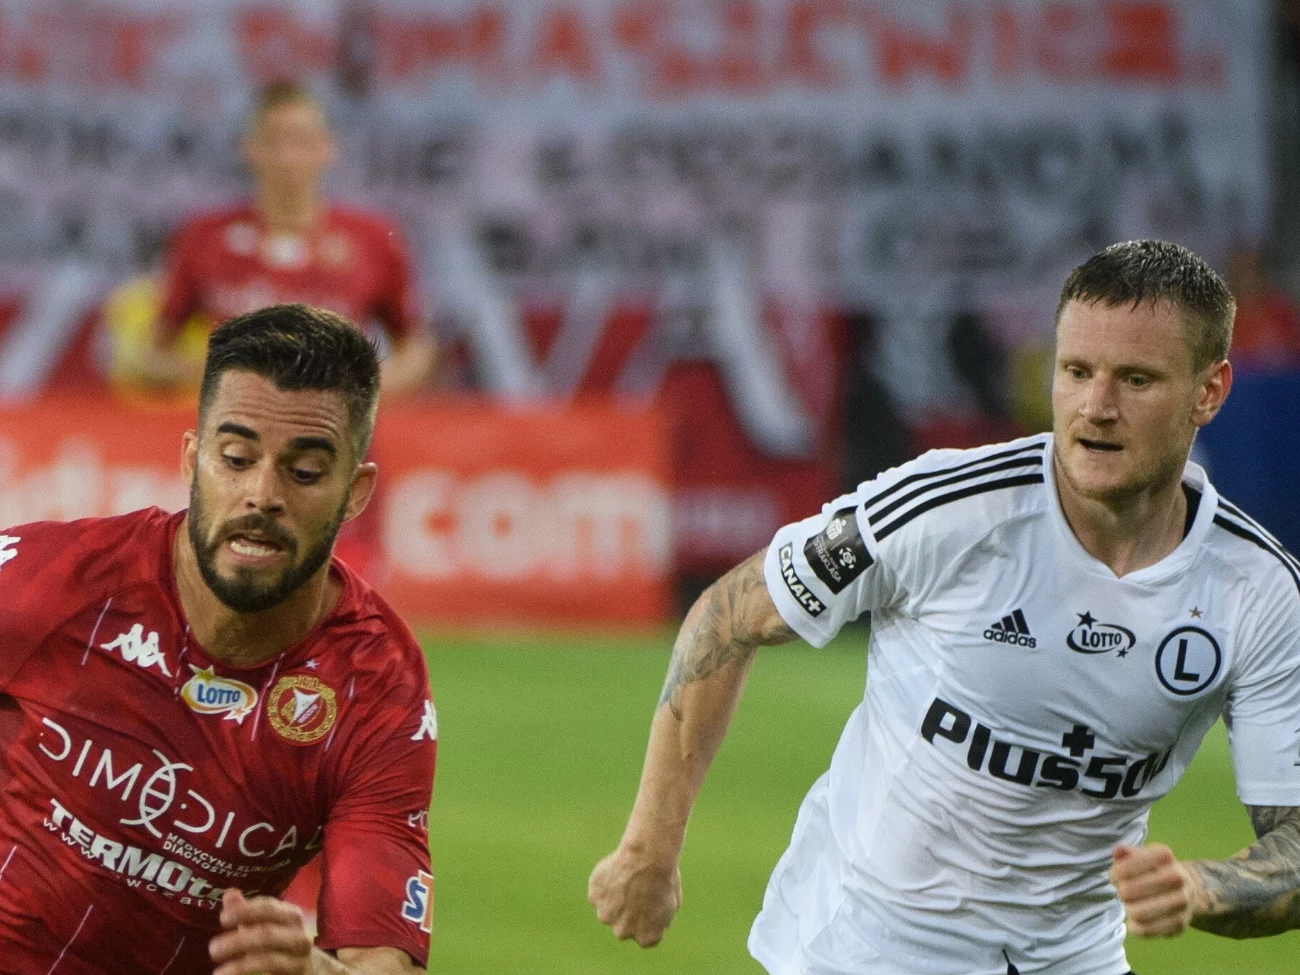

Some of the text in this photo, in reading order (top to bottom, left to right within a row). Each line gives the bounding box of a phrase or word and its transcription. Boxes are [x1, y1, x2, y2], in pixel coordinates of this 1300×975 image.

[780, 545, 821, 613] CANAL+
[983, 627, 1037, 649] adidas
[1082, 629, 1122, 648] LOTTO
[1174, 638, 1200, 683] L
[197, 683, 241, 704] LOTTO
